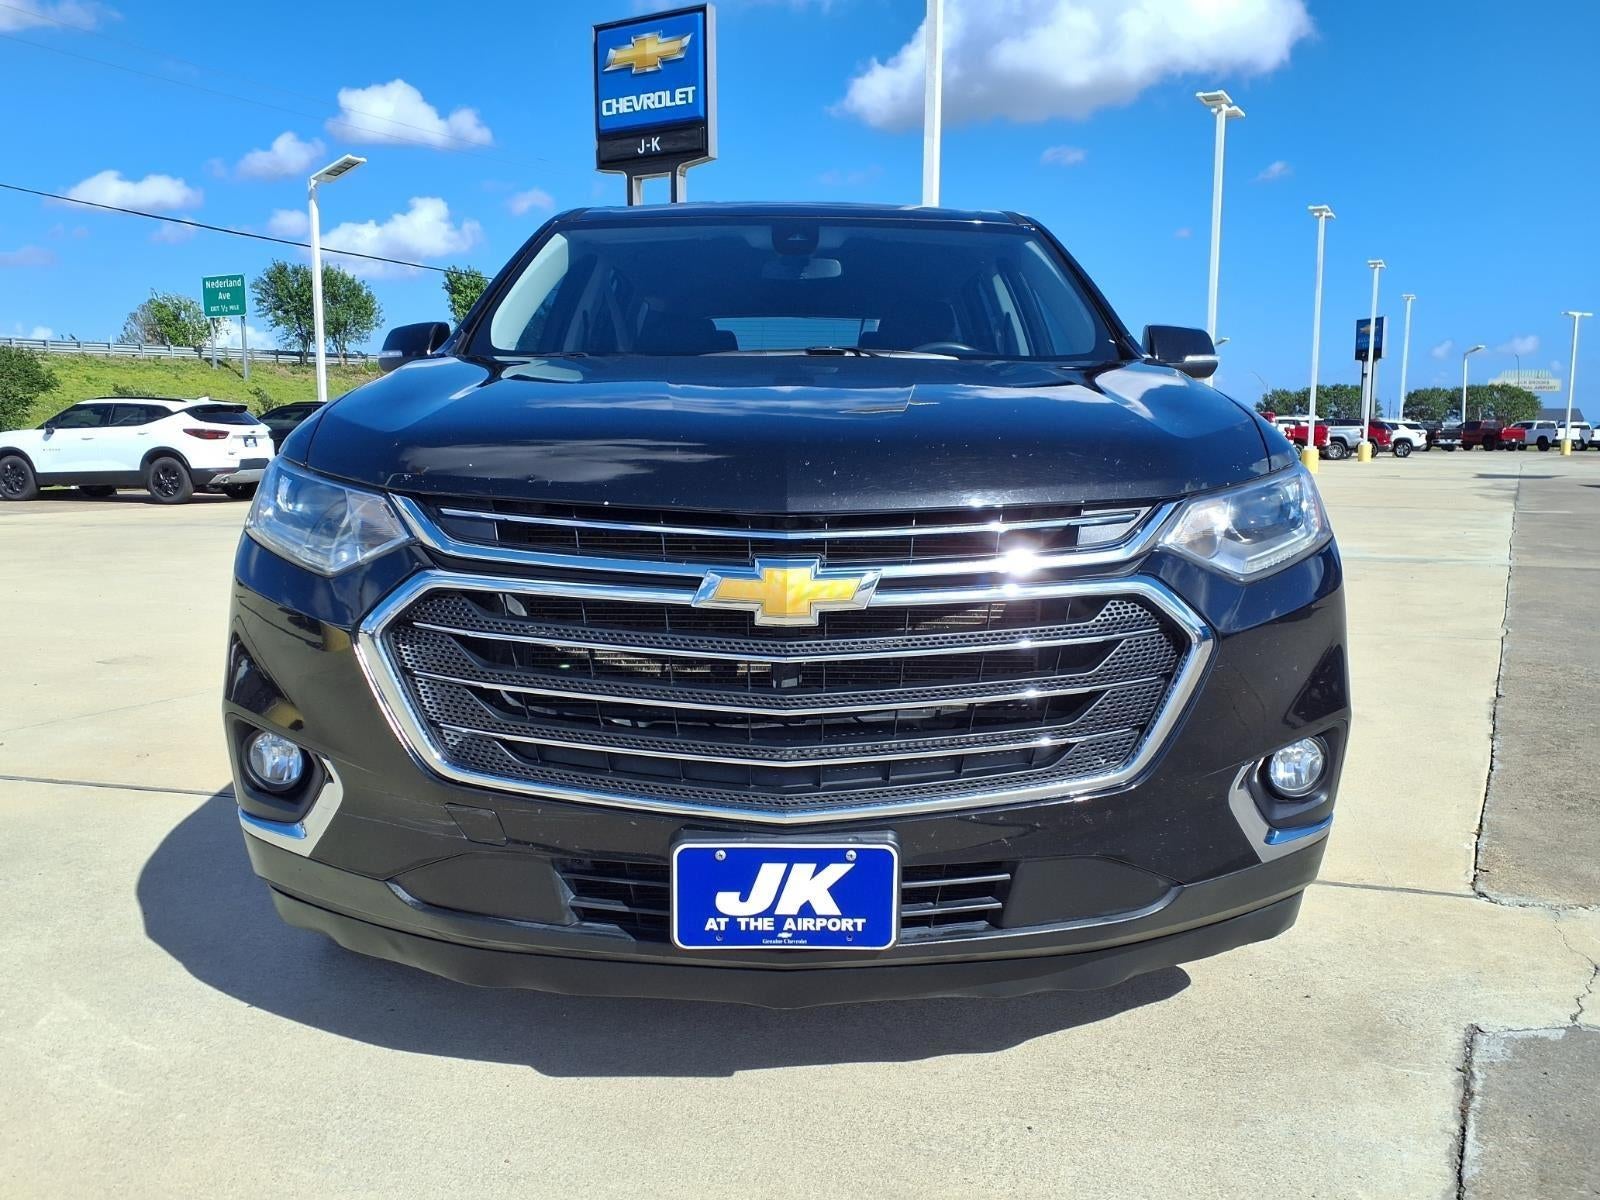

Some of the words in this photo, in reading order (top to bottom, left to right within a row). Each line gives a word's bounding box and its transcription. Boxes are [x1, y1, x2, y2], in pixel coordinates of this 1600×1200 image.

[602, 86, 696, 116] CHEVROLET
[638, 137, 660, 154] J-K
[205, 278, 242, 289] Nederland
[218, 291, 231, 300] Ave
[715, 863, 856, 916] JK
[704, 918, 730, 931] AT
[737, 918, 774, 931] THE
[782, 918, 866, 932] AIRPORT
